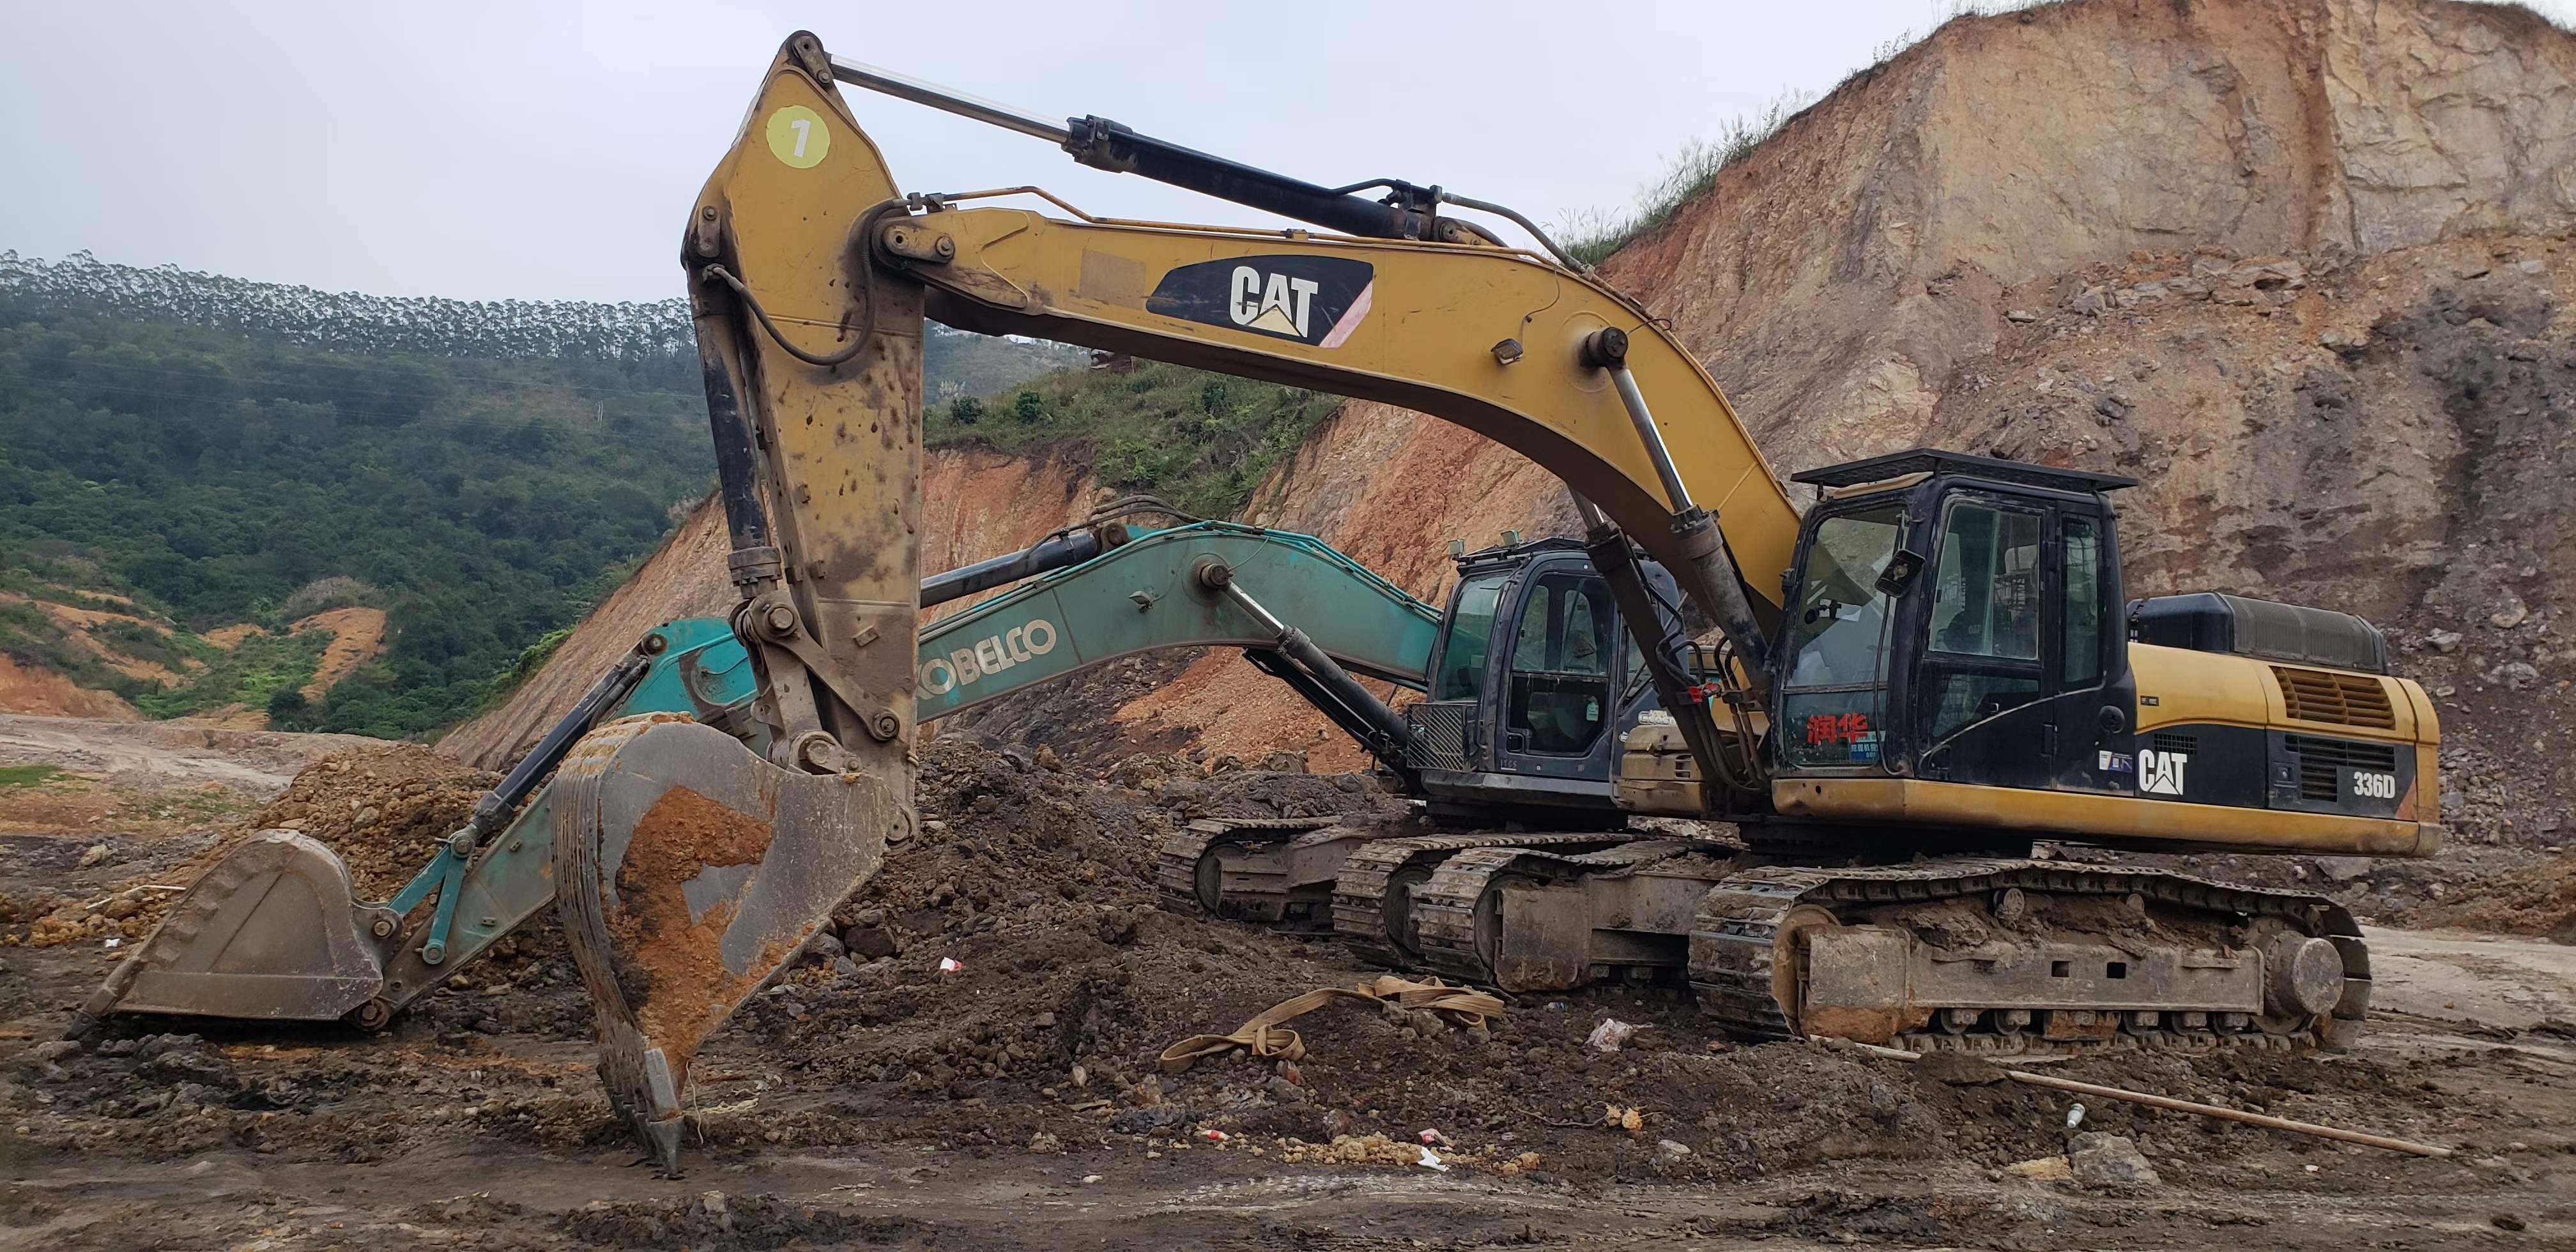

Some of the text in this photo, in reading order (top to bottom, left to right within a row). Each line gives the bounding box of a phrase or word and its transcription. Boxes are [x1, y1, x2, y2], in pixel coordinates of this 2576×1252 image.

[790, 118, 811, 158] 1
[1229, 266, 1319, 338] CAT
[1807, 712, 1868, 745] 润华
[2139, 749, 2188, 795] CAT
[2354, 772, 2395, 798] 336D
